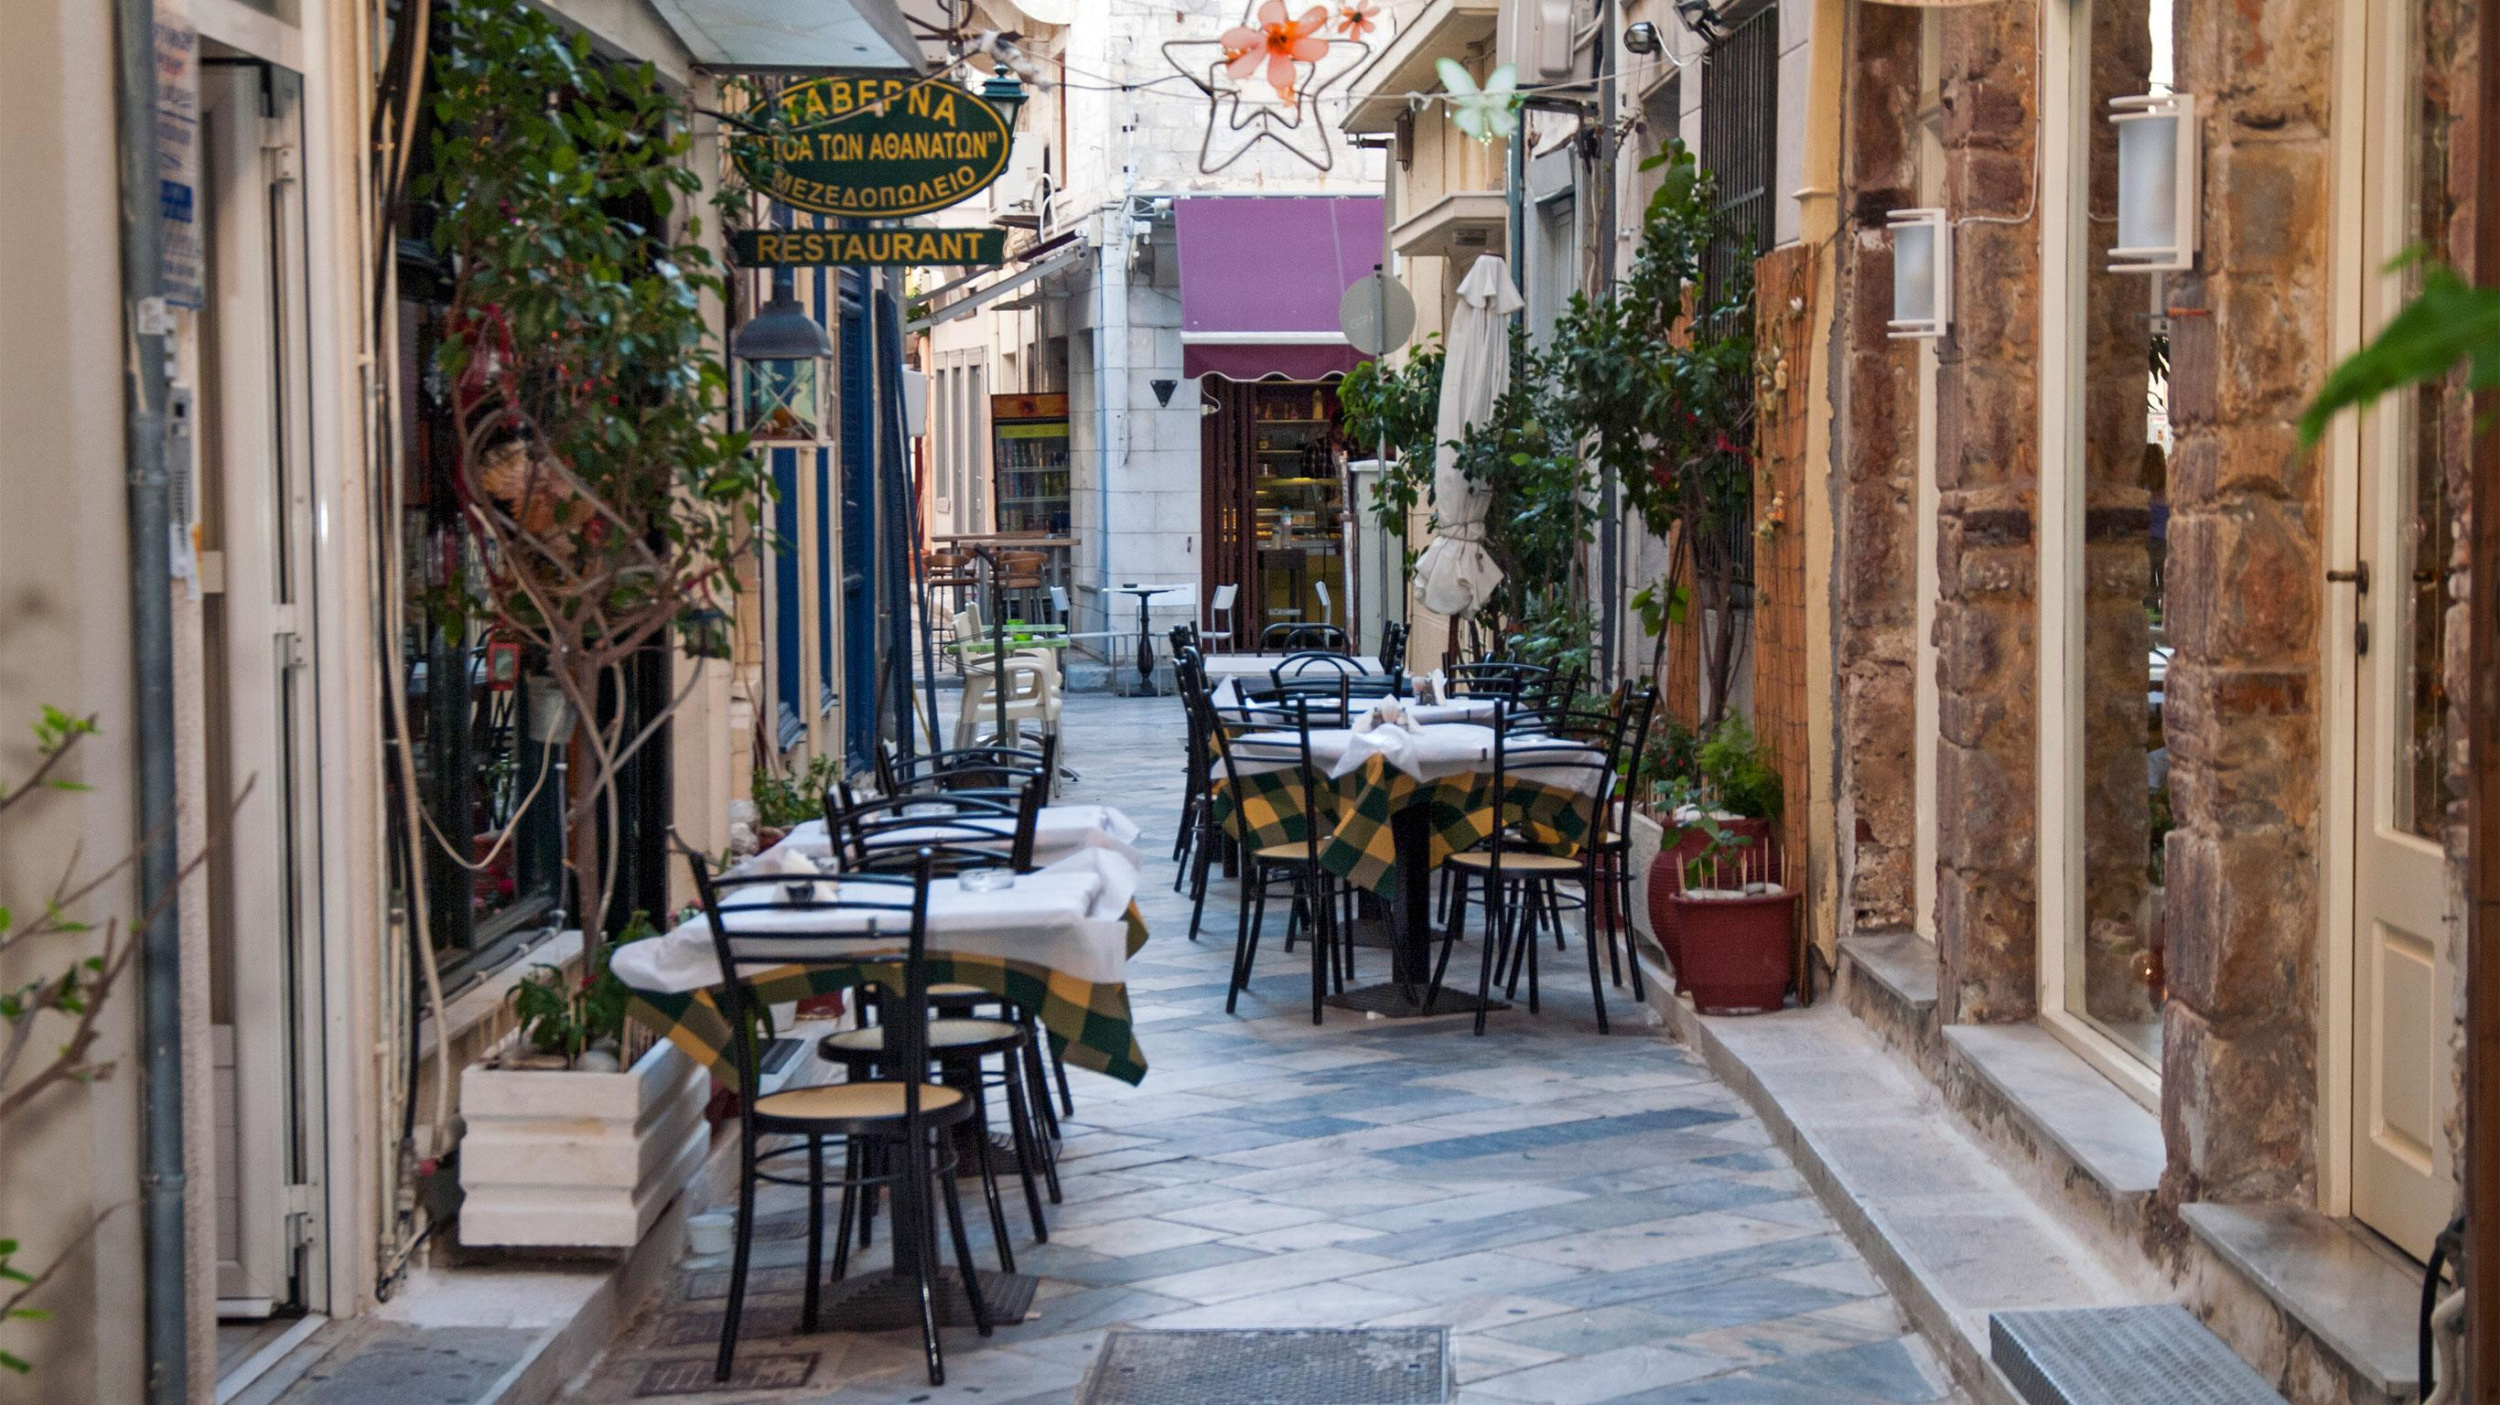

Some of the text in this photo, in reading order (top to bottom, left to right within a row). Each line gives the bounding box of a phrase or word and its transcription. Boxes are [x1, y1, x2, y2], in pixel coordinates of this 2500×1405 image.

[781, 80, 956, 126] ΤΑΒΕΡΝΑ
[818, 133, 863, 161] ΤΩΝ
[774, 165, 976, 207] ΜΕΖΕΔΟΠΩΛΕΙΟ
[756, 232, 983, 262] RESTAURANT
